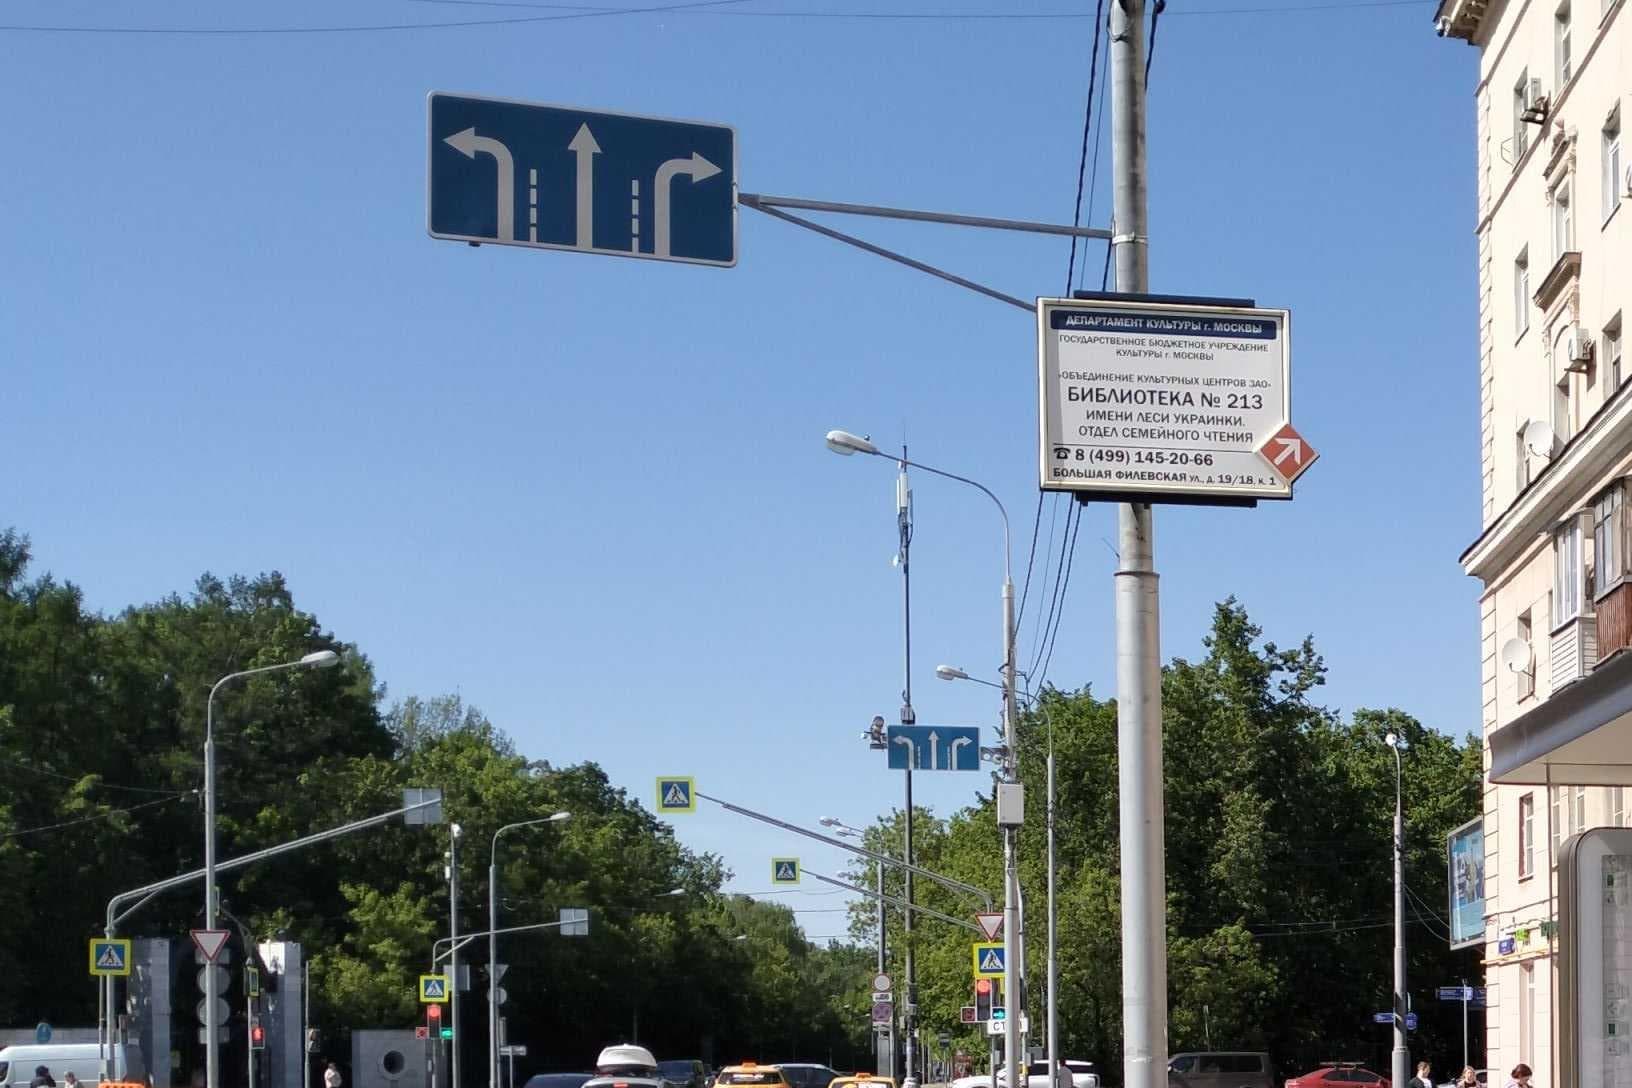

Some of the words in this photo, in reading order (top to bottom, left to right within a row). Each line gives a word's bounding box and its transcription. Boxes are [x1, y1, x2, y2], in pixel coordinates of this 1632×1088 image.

[1066, 315, 1142, 328] ДЕПАРТАМЕНТ
[1146, 319, 1201, 331] КУЛЬТУРЫ
[1214, 323, 1262, 334] МОСКВЫ
[1060, 334, 1146, 346] ГОСУДАРСТВЕННОЕ
[1149, 339, 1207, 350] БЮДЖЕТНОЕ
[1209, 342, 1268, 353] УЧРЕЖДЕНИЕ
[1116, 349, 1162, 359] КУЛЬТУРЫ
[1173, 351, 1214, 361] МОСКВЫ
[1137, 374, 1199, 385] КУЛЬТУРНЫХ
[1203, 377, 1247, 388] ЦЕНТРОВ
[1068, 386, 1194, 407] БИБЛИОТЕКА
[1201, 392, 1221, 408] №
[1227, 393, 1263, 410] 213
[1086, 409, 1133, 422] ИМЕНИ
[1137, 411, 1170, 424] ЛЕСИ
[1174, 413, 1246, 427] УКРАИНКИ.
[1079, 425, 1118, 438] ОТДЕЛ
[1122, 426, 1200, 441] СЕМЕЙНОГО
[1204, 430, 1253, 443] ЧТЕНИЯ
[1075, 449, 1085, 461] 8
[1089, 448, 1130, 465] (499)
[1135, 451, 1213, 466] 145-20-66
[1053, 467, 1111, 479] БОЛЬШАЯ
[1115, 469, 1187, 481] ФИЛЕВСКАЯ
[1269, 477, 1277, 486] 1
